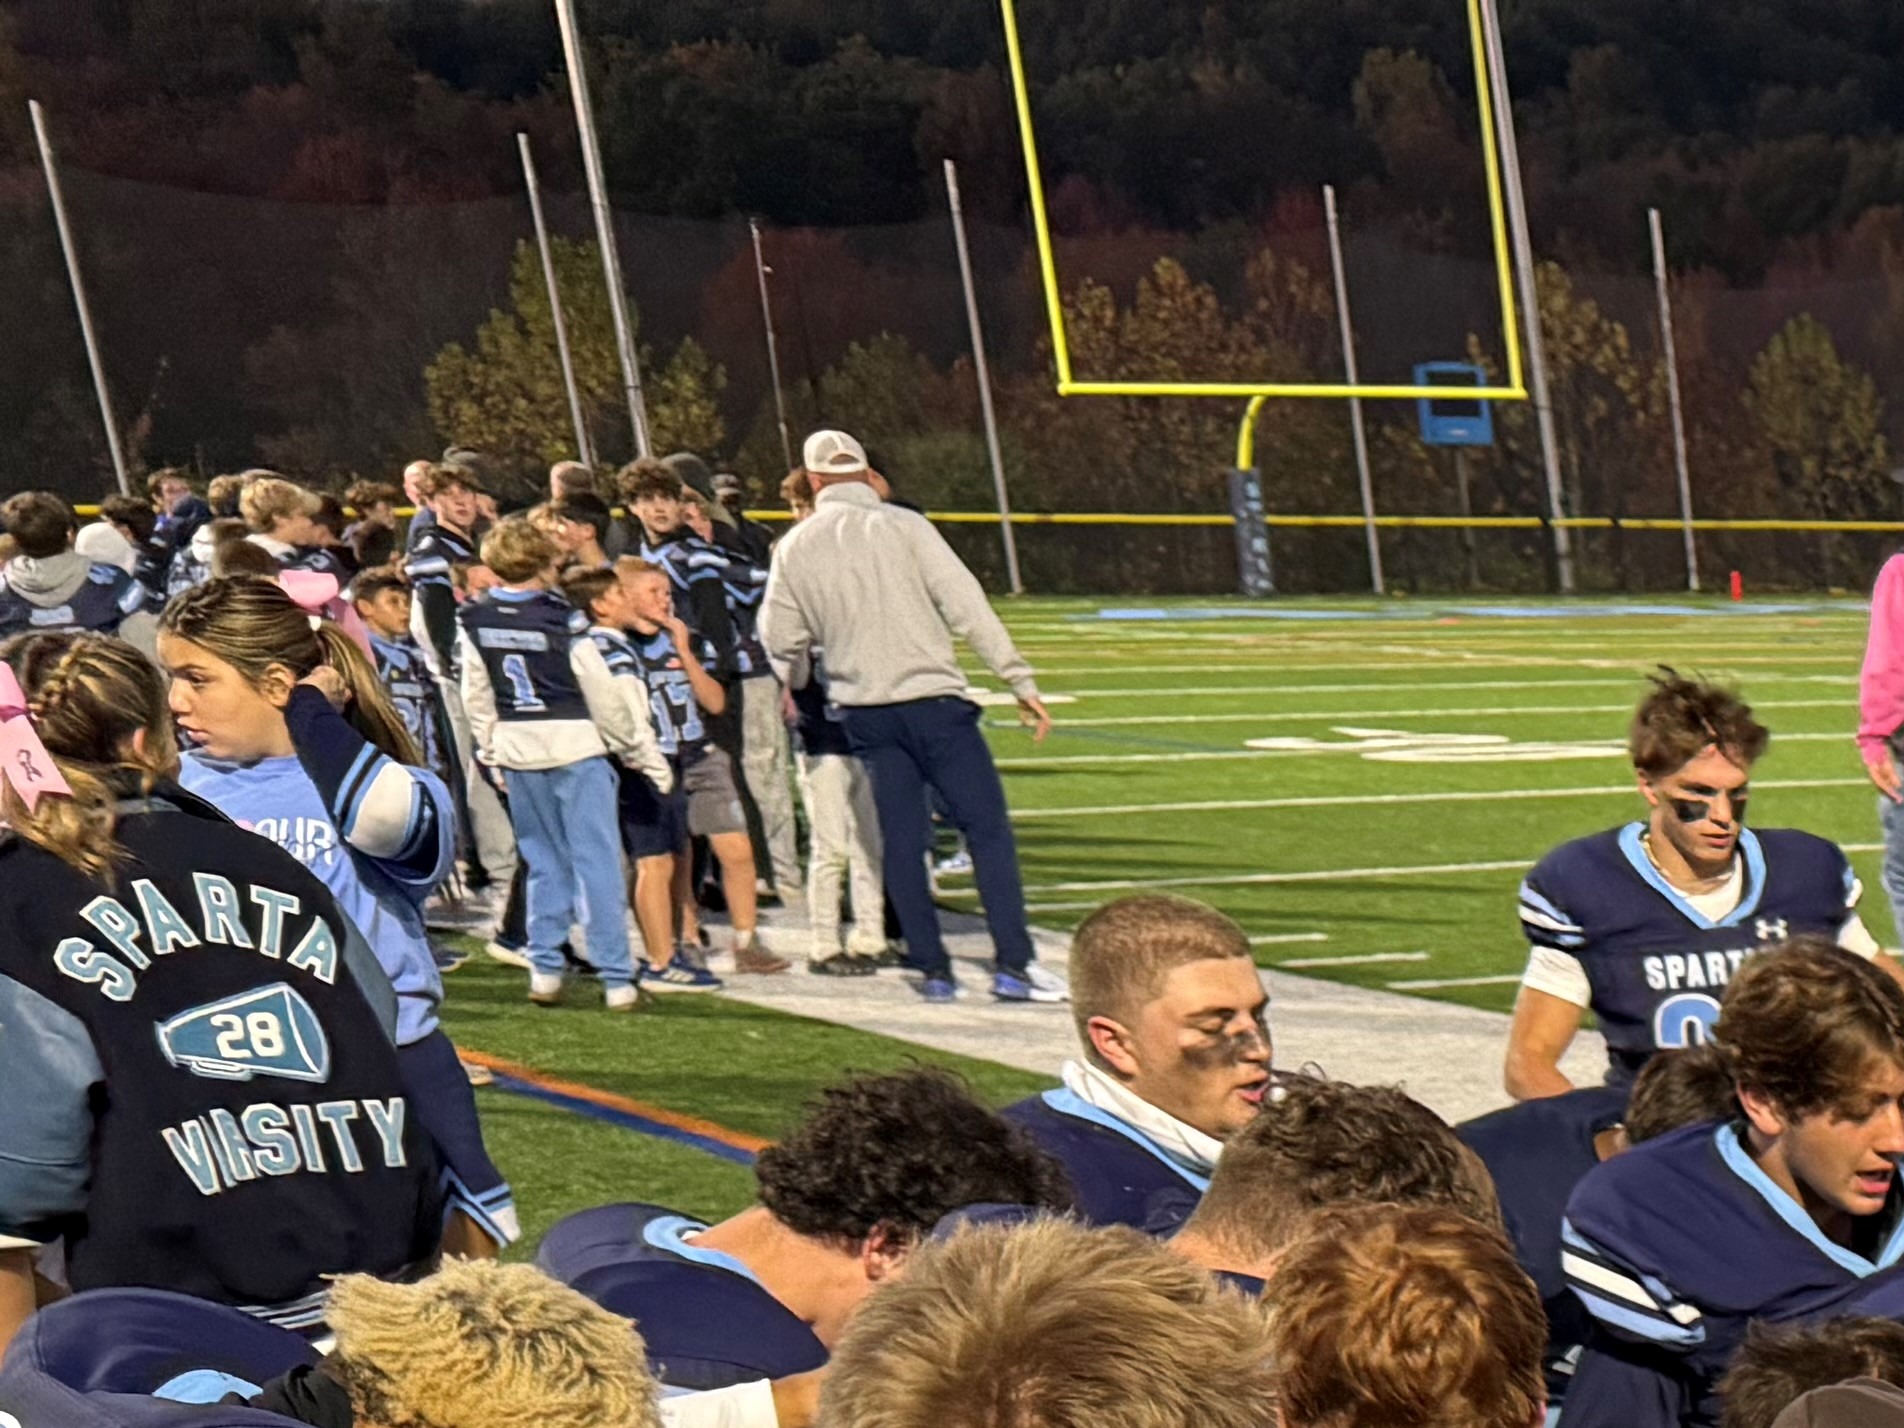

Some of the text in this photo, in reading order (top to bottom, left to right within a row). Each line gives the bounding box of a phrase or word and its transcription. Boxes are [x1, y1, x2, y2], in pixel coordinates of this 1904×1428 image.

[502, 654, 547, 712] 1
[54, 872, 339, 1002] SPARTA
[1643, 948, 1756, 990] SPART
[210, 1011, 285, 1059] 28
